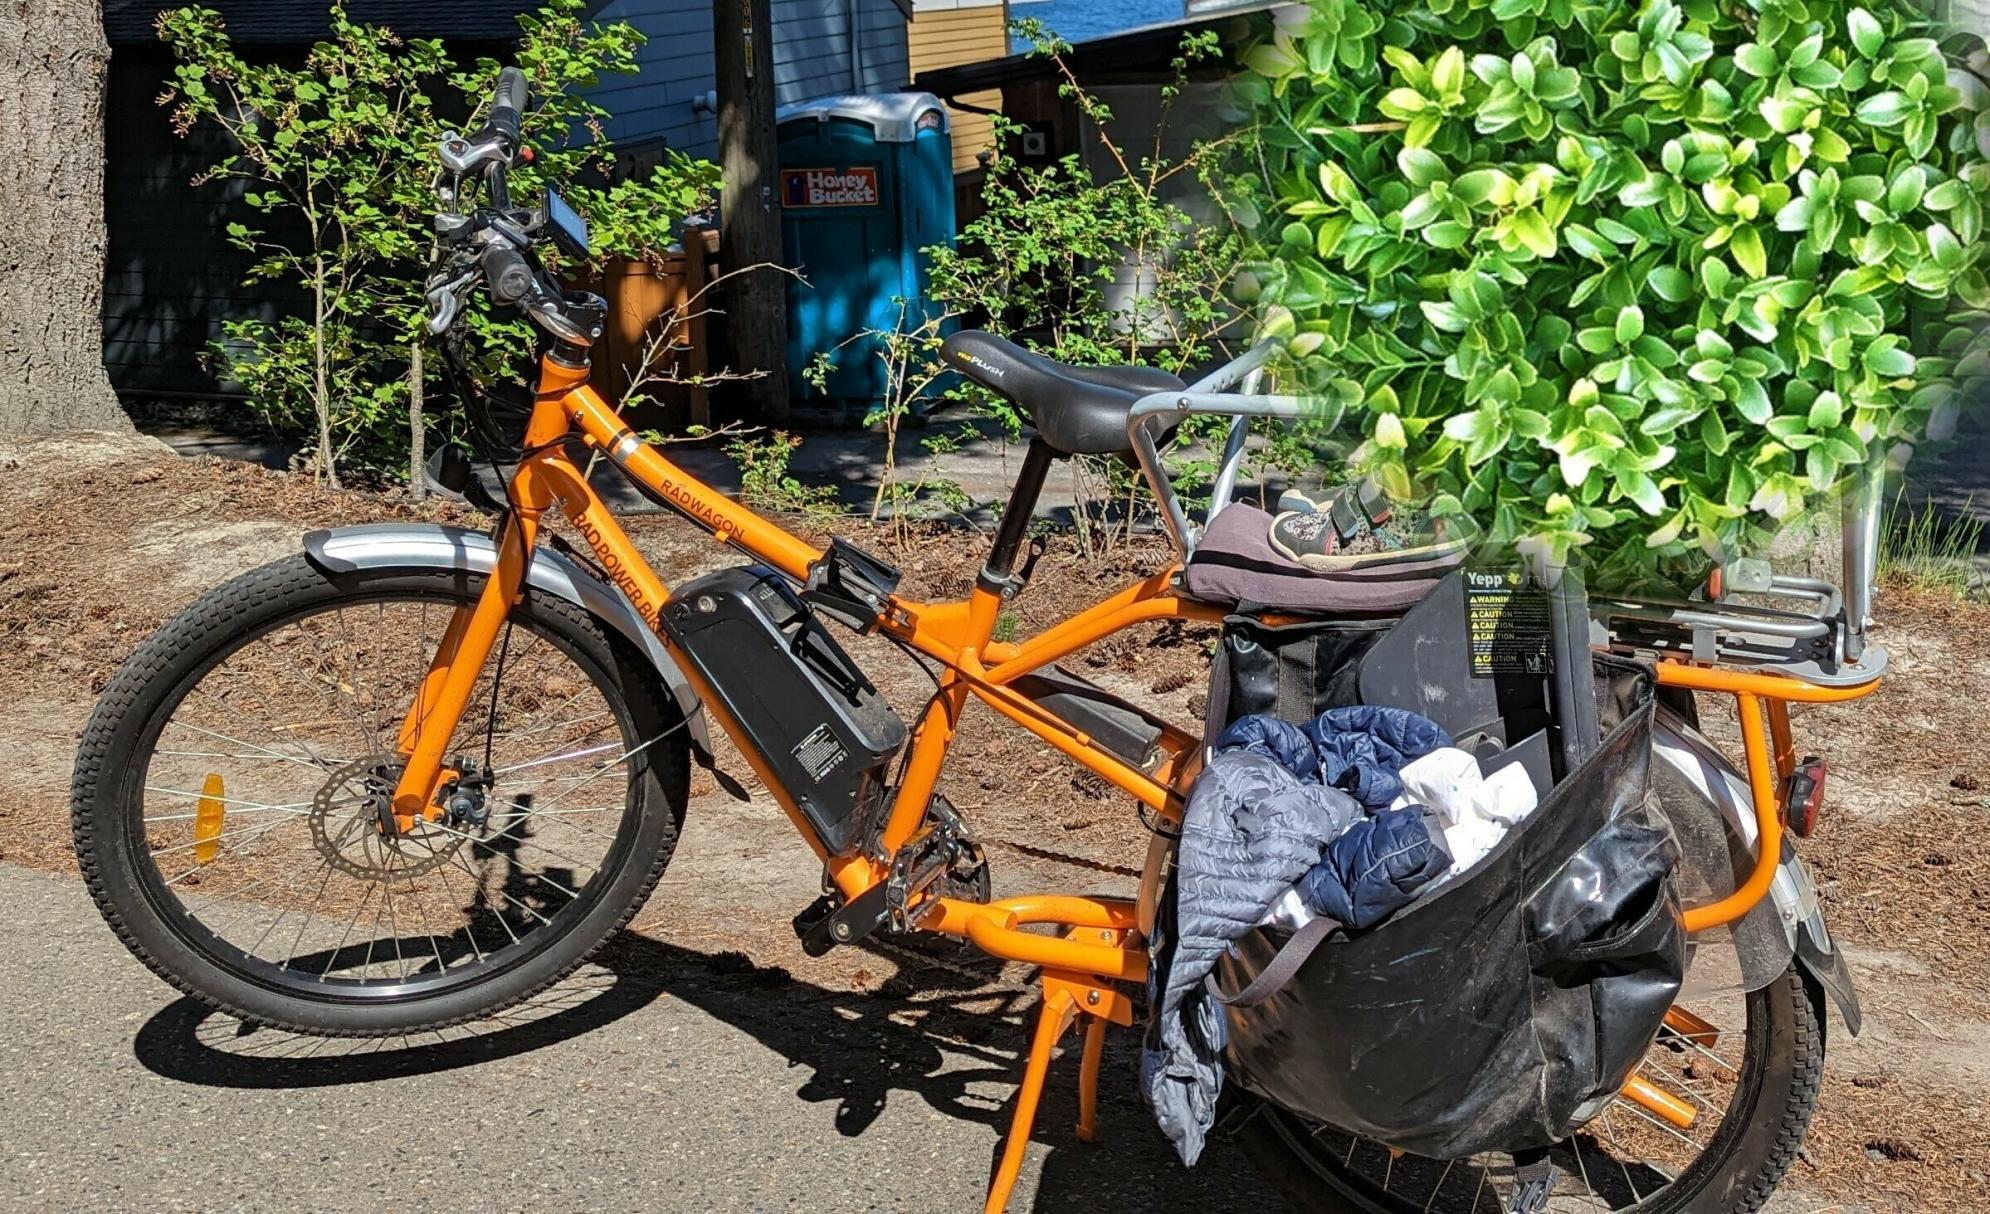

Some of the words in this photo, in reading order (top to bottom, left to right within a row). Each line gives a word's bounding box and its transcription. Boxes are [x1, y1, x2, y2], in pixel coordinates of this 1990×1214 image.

[807, 172, 868, 190] Honey
[809, 187, 875, 204] Bucket
[970, 356, 1005, 377] PLUSH
[661, 479, 745, 539] RADWAGON
[572, 513, 601, 548] RAD
[595, 543, 643, 605] POWER
[640, 601, 671, 648] BIKES
[1467, 572, 1503, 588] Yepp
[1479, 610, 1513, 618] CAUTION
[1480, 621, 1514, 629] CAUTION
